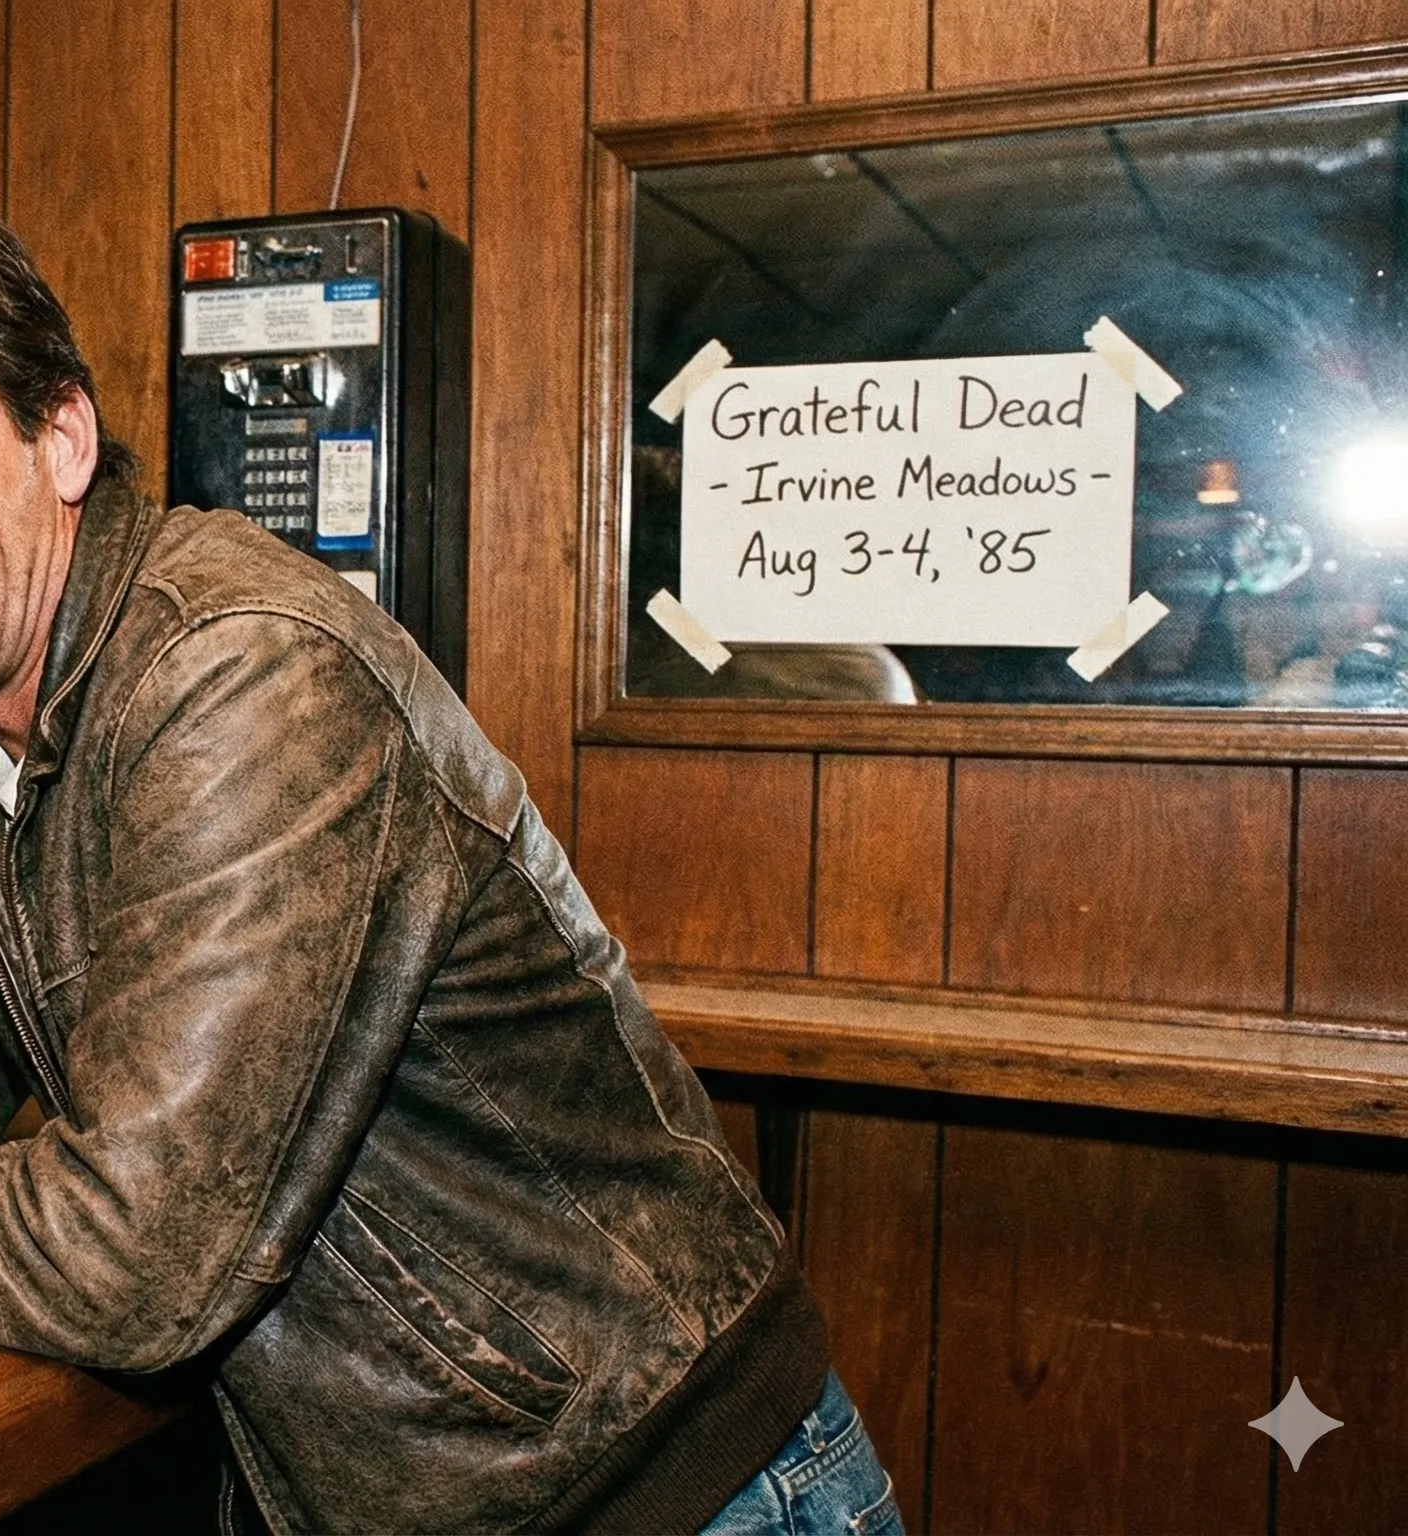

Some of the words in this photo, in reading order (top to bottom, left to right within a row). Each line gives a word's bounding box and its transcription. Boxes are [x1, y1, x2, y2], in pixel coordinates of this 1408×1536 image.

[711, 379, 920, 441] Grateful
[958, 373, 1088, 430] Dead
[737, 530, 817, 597] Aug
[840, 527, 941, 584] 3-4,
[966, 526, 1052, 575] '85
